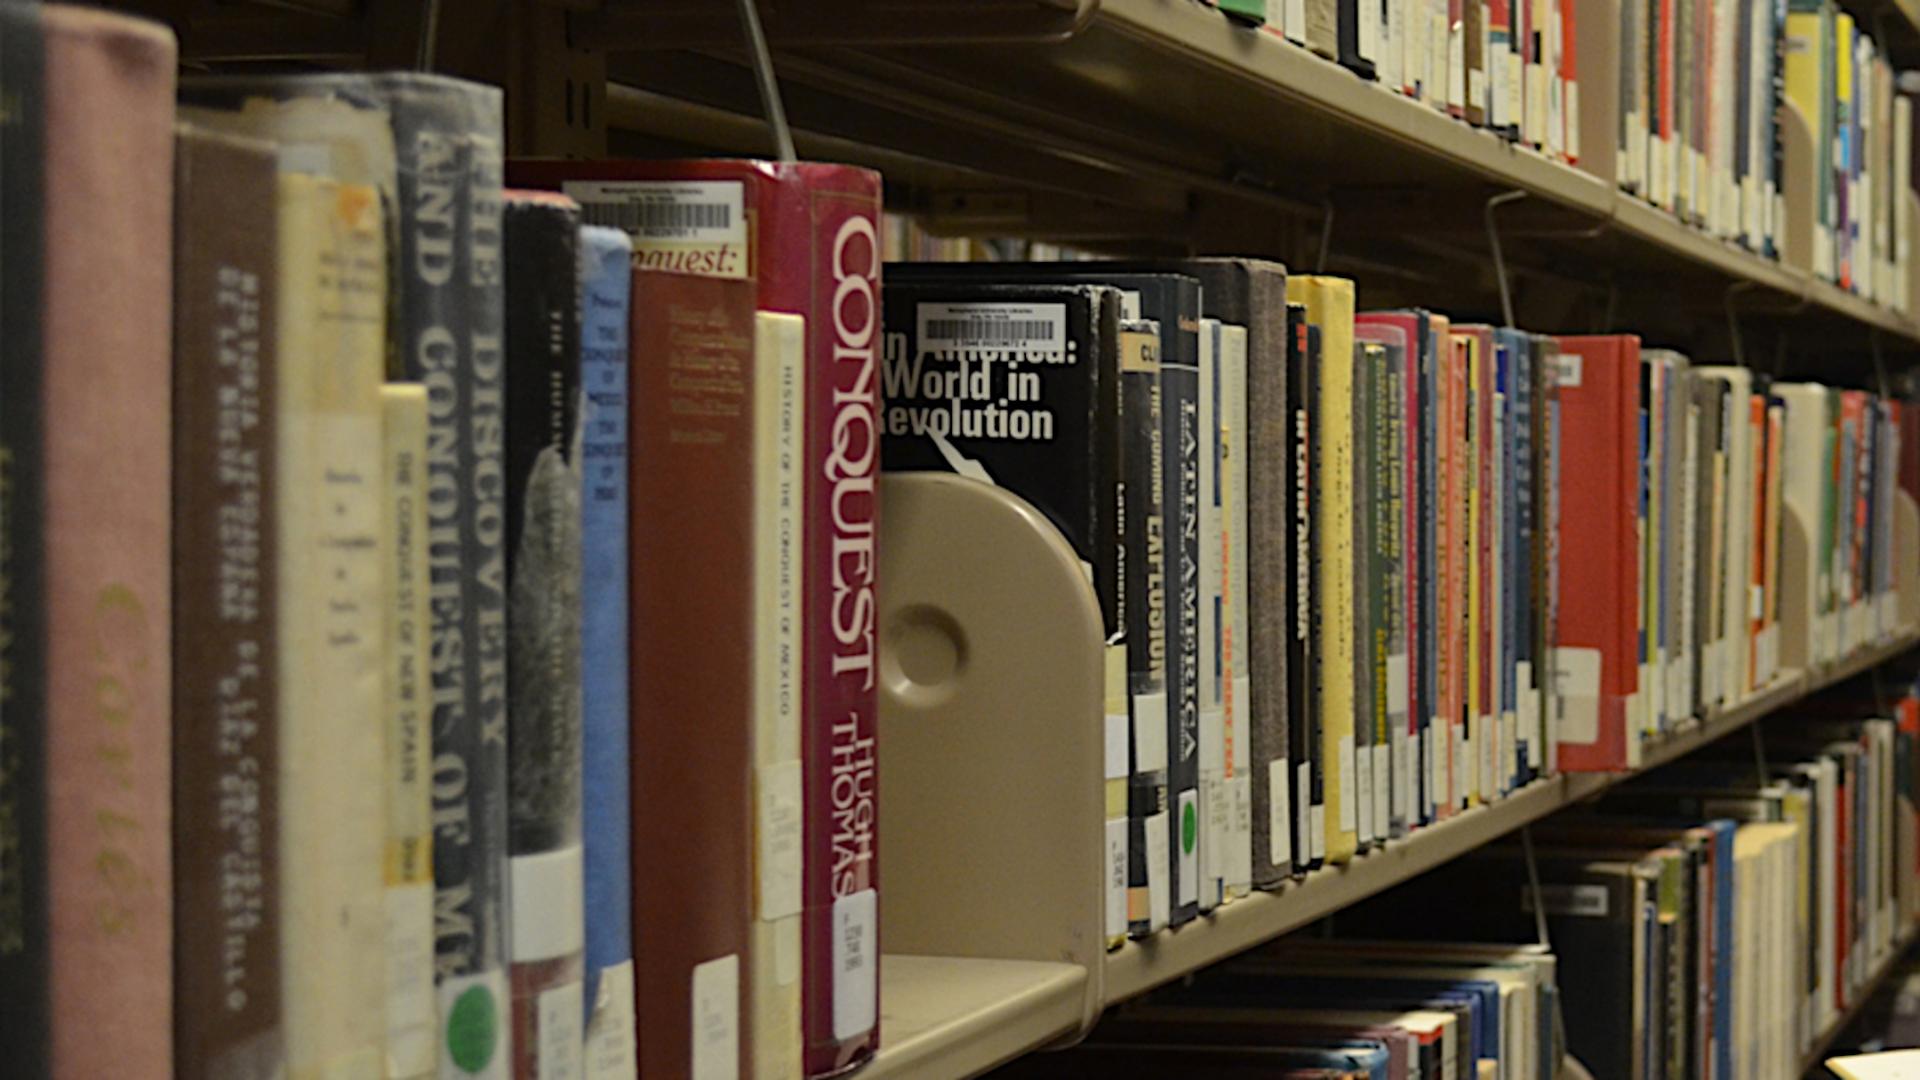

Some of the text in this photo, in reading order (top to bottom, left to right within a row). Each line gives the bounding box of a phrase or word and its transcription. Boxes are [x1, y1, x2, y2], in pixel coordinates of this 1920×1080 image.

[416, 130, 457, 287] AND
[883, 352, 1041, 402] World in
[397, 450, 419, 487] THE
[825, 215, 878, 692] CONQUEST
[397, 496, 419, 613] CONQUEST
[473, 332, 506, 746] DISCOVERY
[780, 365, 793, 716] HISTORY OF THE CONQUEST OF MEXICO
[1116, 483, 1127, 634] Latin America
[1184, 400, 1197, 761] LATIN AMERICA
[399, 620, 418, 646] OF
[432, 752, 471, 846] OF
[832, 712, 859, 898] THOMAS
[854, 737, 875, 863] HUGH
